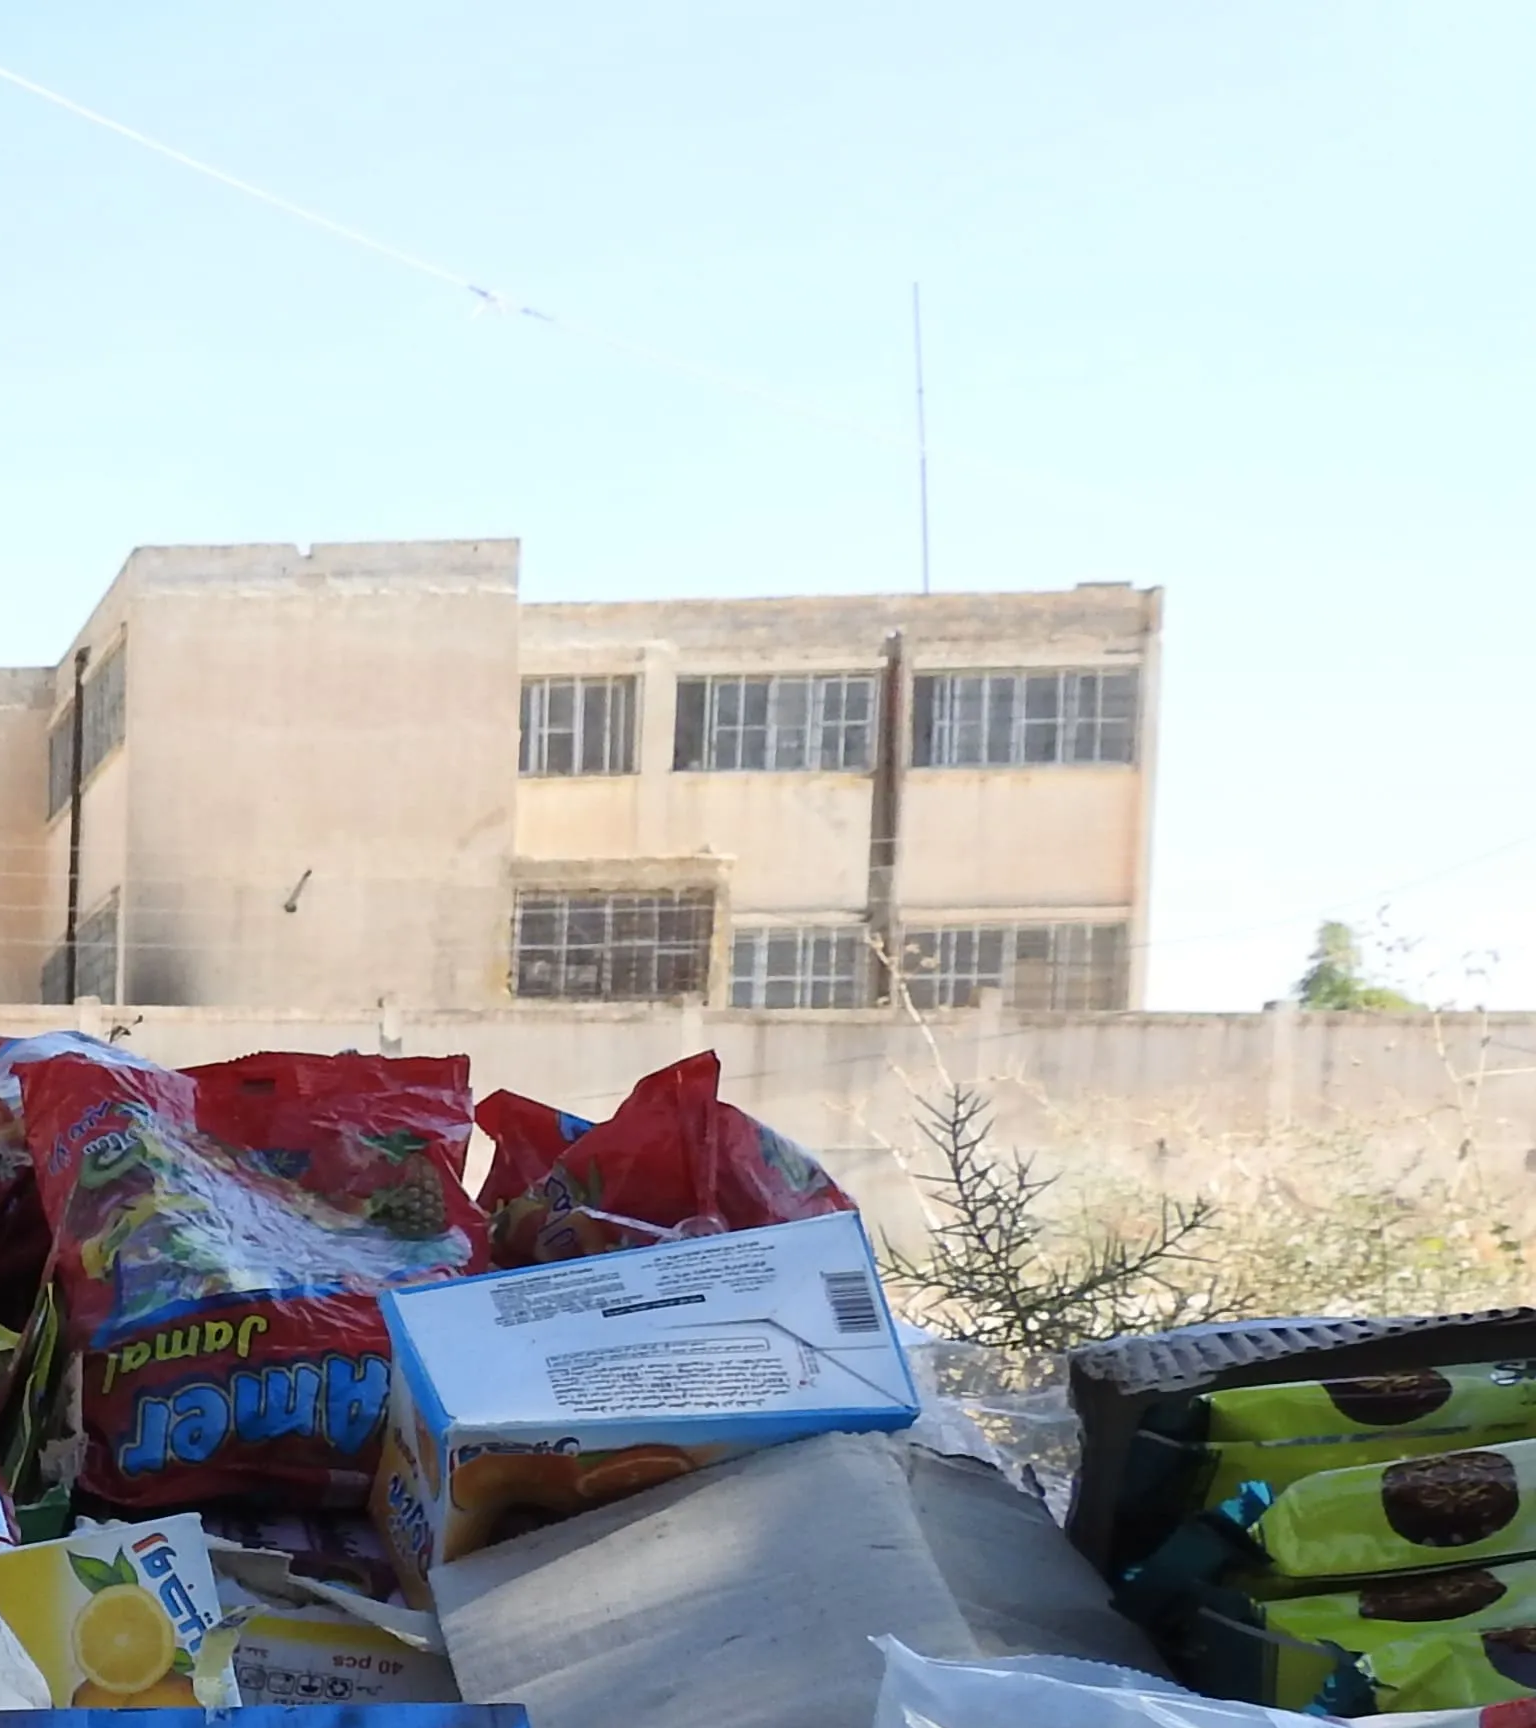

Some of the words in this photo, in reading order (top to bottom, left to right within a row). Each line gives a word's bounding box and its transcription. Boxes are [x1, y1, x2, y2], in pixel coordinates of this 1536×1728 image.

[102, 1315, 268, 1393] Jamal
[119, 1355, 393, 1477] Amer
[379, 1661, 404, 1676] 40
